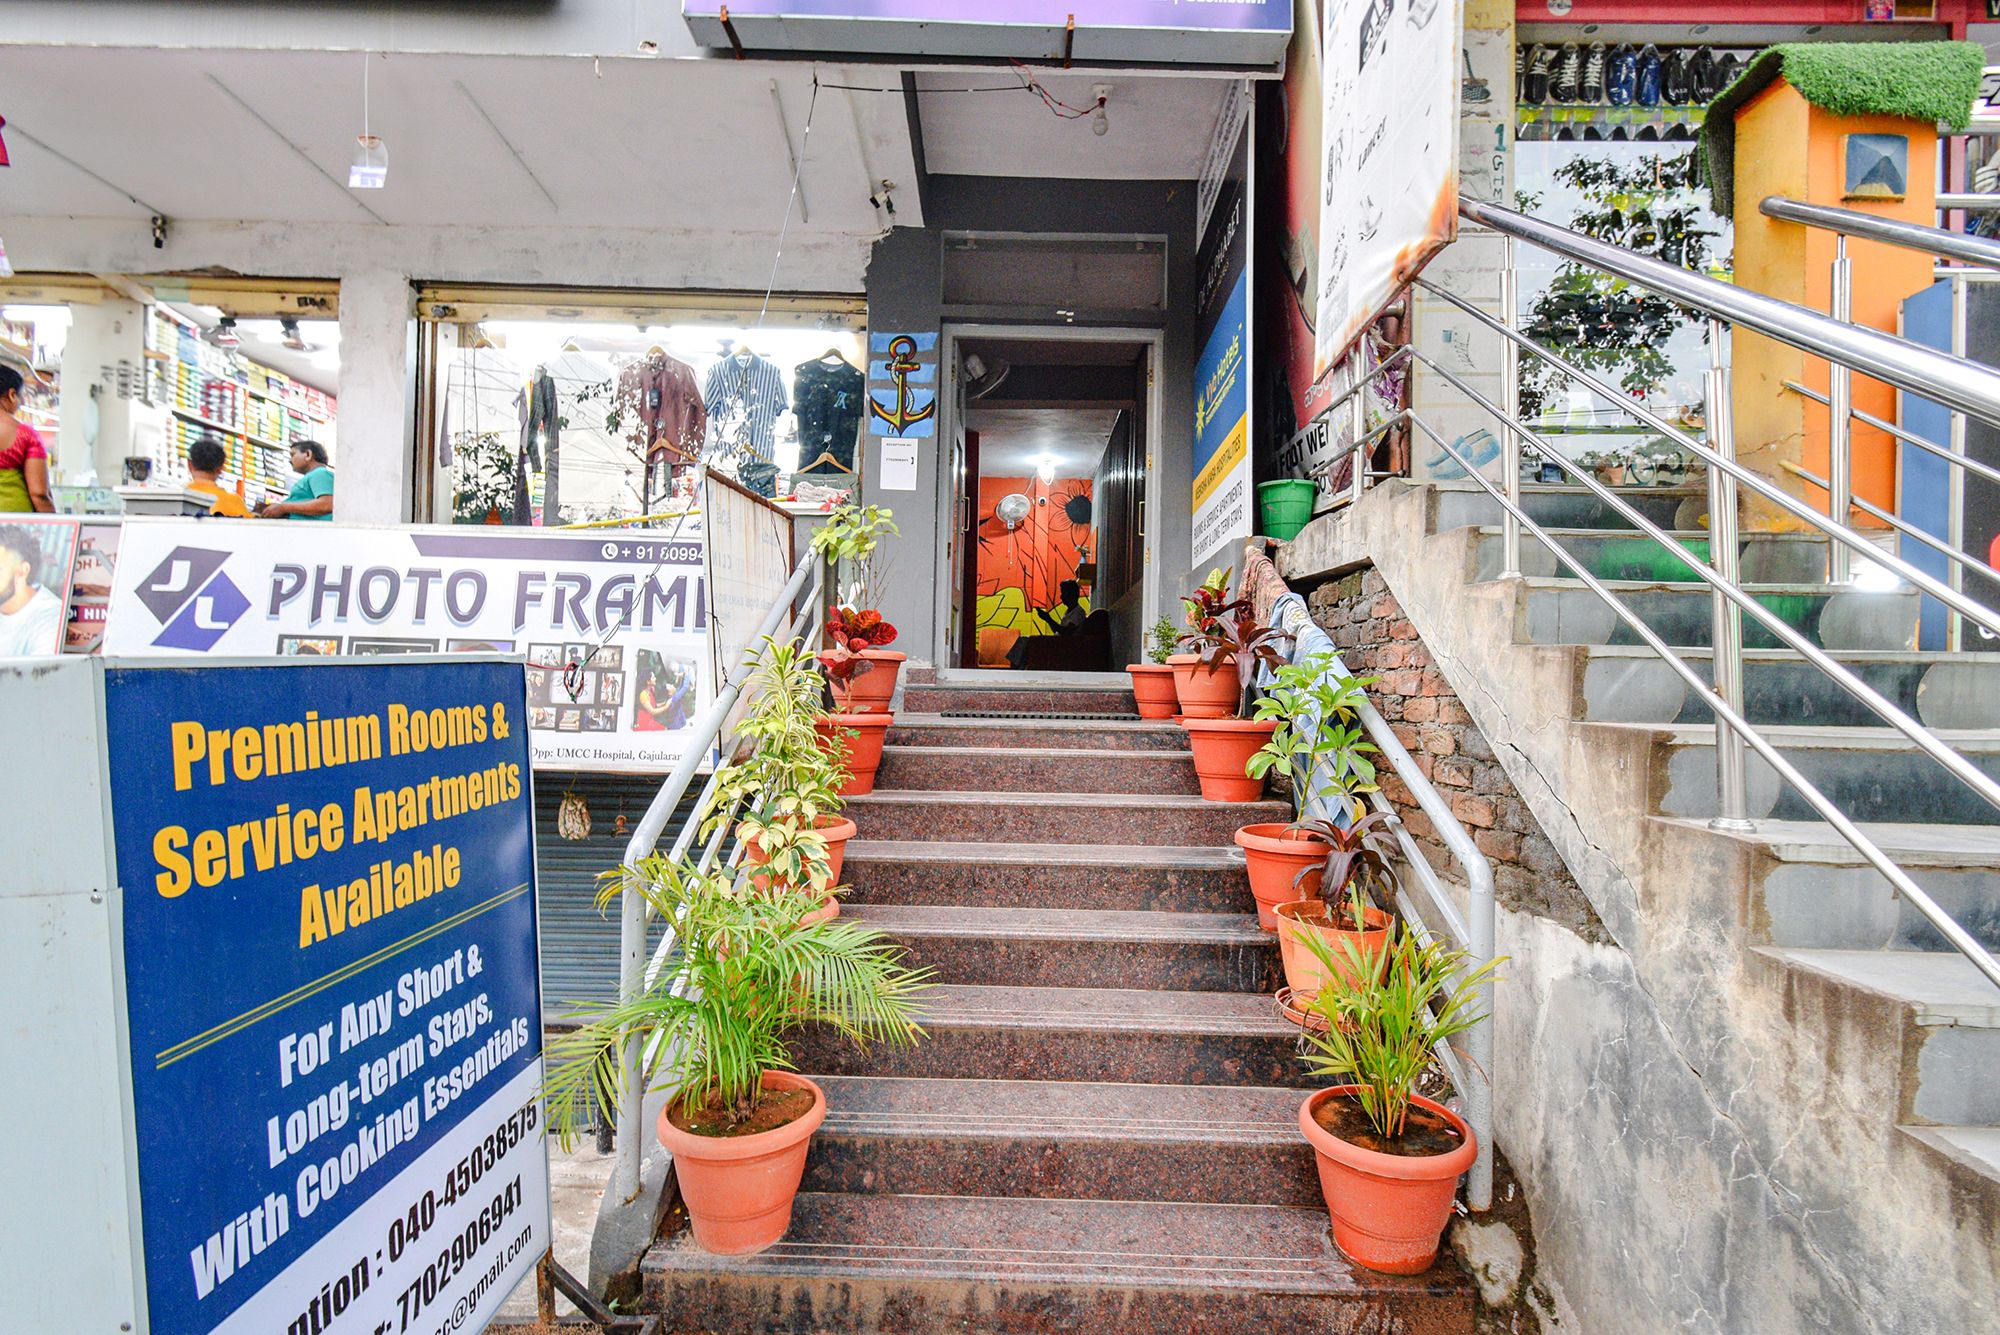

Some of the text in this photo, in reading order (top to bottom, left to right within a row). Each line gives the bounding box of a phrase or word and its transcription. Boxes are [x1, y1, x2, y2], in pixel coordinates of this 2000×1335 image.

[1492, 155, 1504, 206] GHM
[1279, 438, 1303, 475] FOOT
[1306, 423, 1328, 455] WE
[267, 563, 489, 627] PHOTO
[636, 545, 654, 559] 91
[171, 701, 509, 791] Premium Rooms &
[556, 748, 591, 759] UMCC
[593, 748, 636, 762] Hospital,
[153, 760, 521, 898] Service Apartments
[298, 841, 462, 949] Available
[278, 943, 483, 1088] For Any Short &
[268, 992, 493, 1168] Long-term Stays,
[190, 1016, 529, 1300] With Cooking Essentials
[388, 1096, 537, 1264] 040-45038575
[396, 1174, 523, 1335] 7702906941
